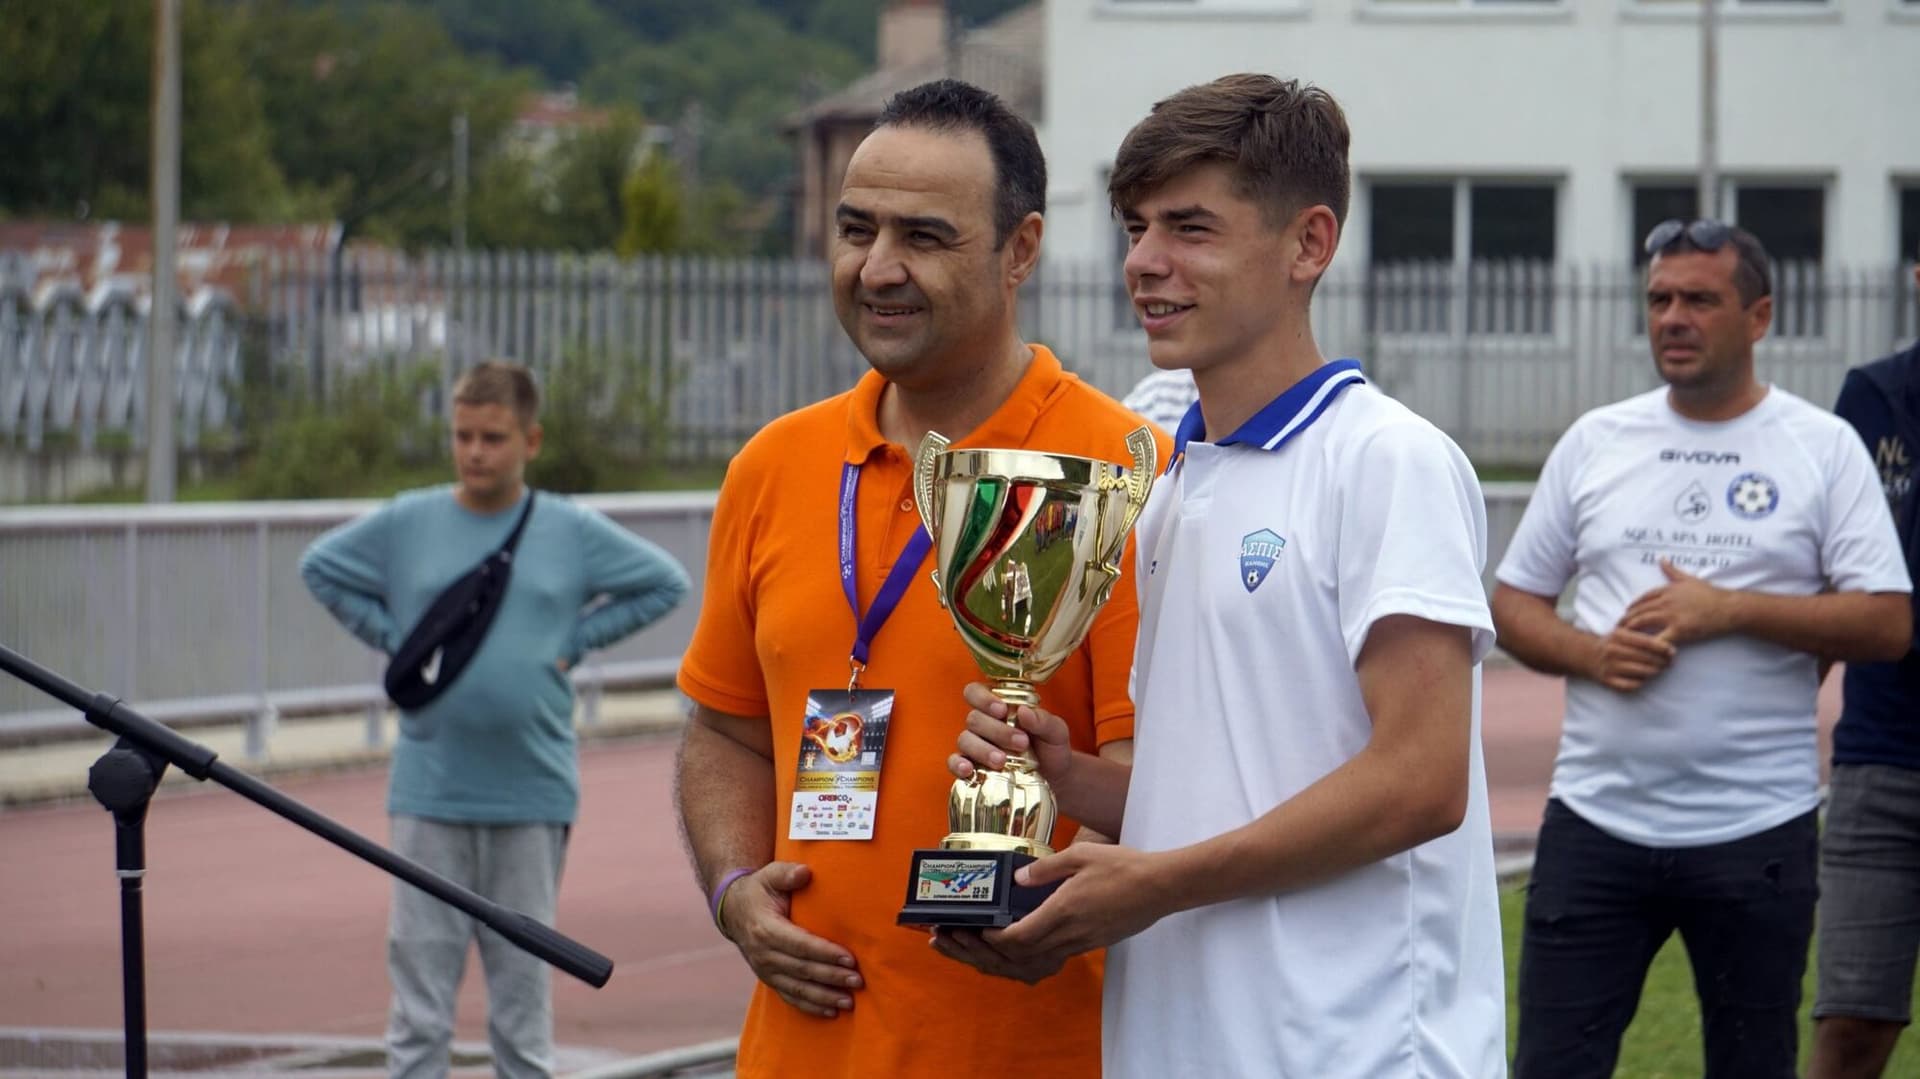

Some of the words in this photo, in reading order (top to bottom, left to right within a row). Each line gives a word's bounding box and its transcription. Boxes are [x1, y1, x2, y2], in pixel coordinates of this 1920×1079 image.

[1659, 448, 1741, 465] GIVOVA
[1622, 527, 1663, 543] AQUA
[1705, 532, 1752, 547] HOTEL
